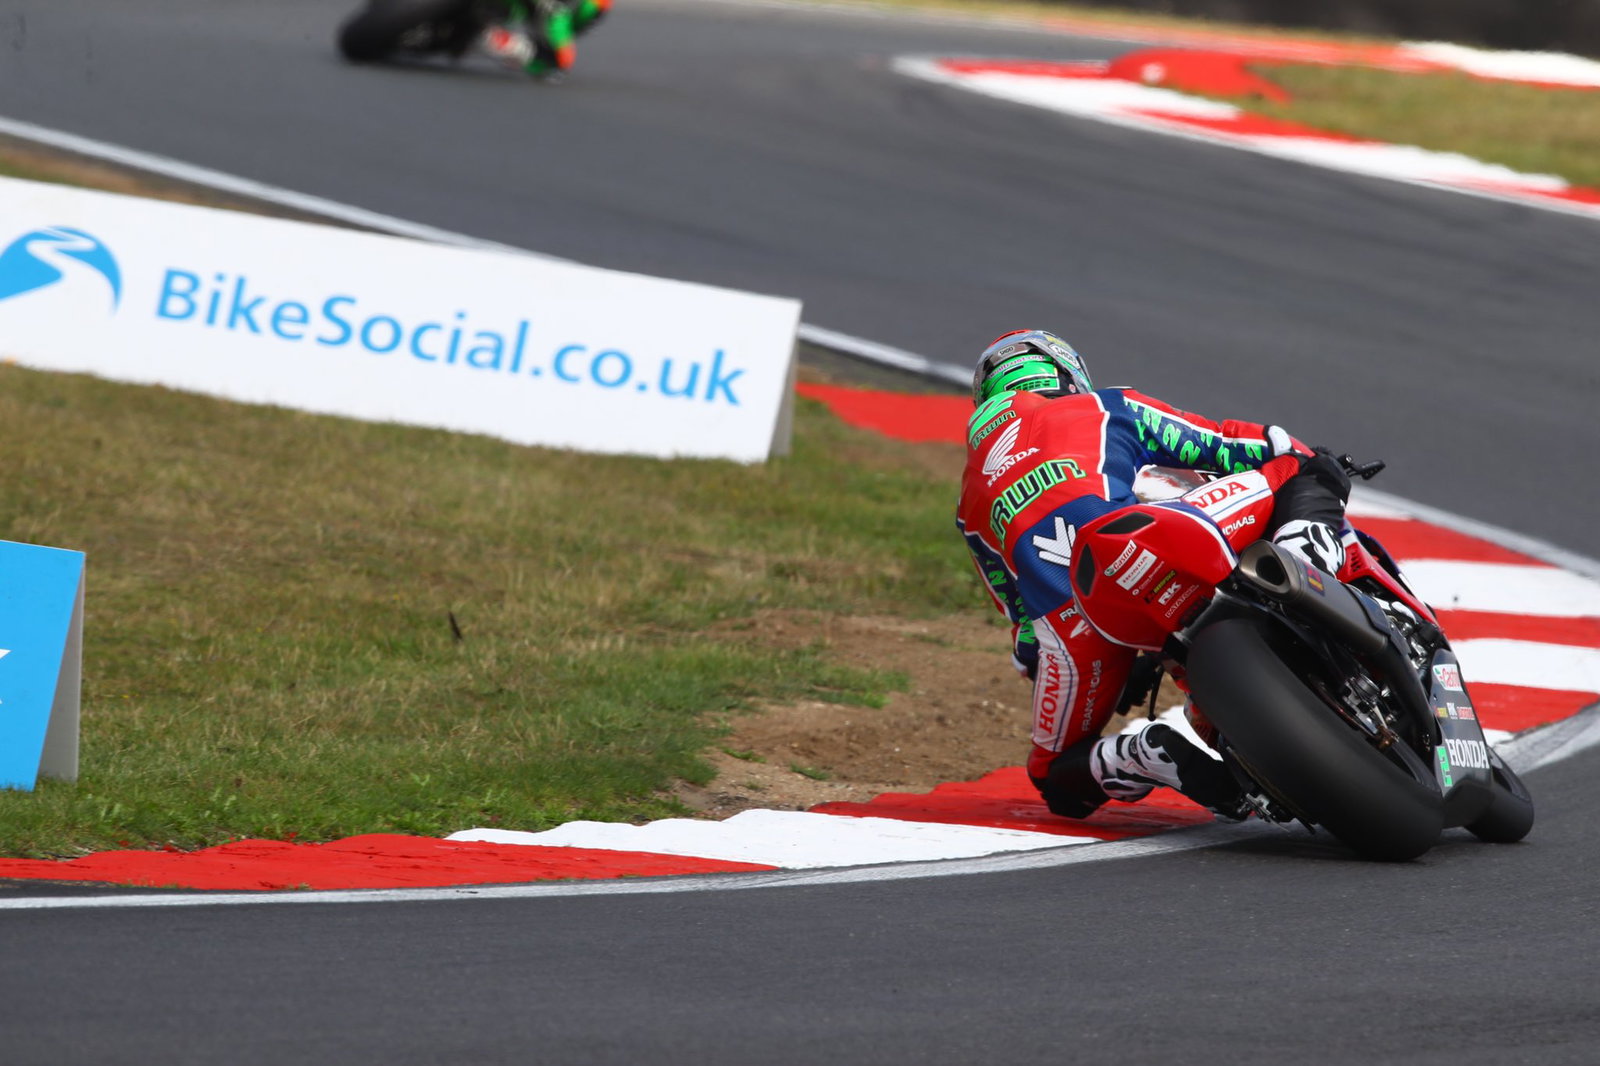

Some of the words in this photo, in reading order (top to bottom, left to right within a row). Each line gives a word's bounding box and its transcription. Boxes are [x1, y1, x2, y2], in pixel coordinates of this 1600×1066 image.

[155, 267, 749, 408] BikeSocial.co.uk
[986, 447, 1041, 488] HONDA
[1190, 481, 1250, 509] NDA
[1158, 581, 1182, 606] RK
[1038, 653, 1061, 735] HONDA
[1444, 738, 1490, 769] HONDA
